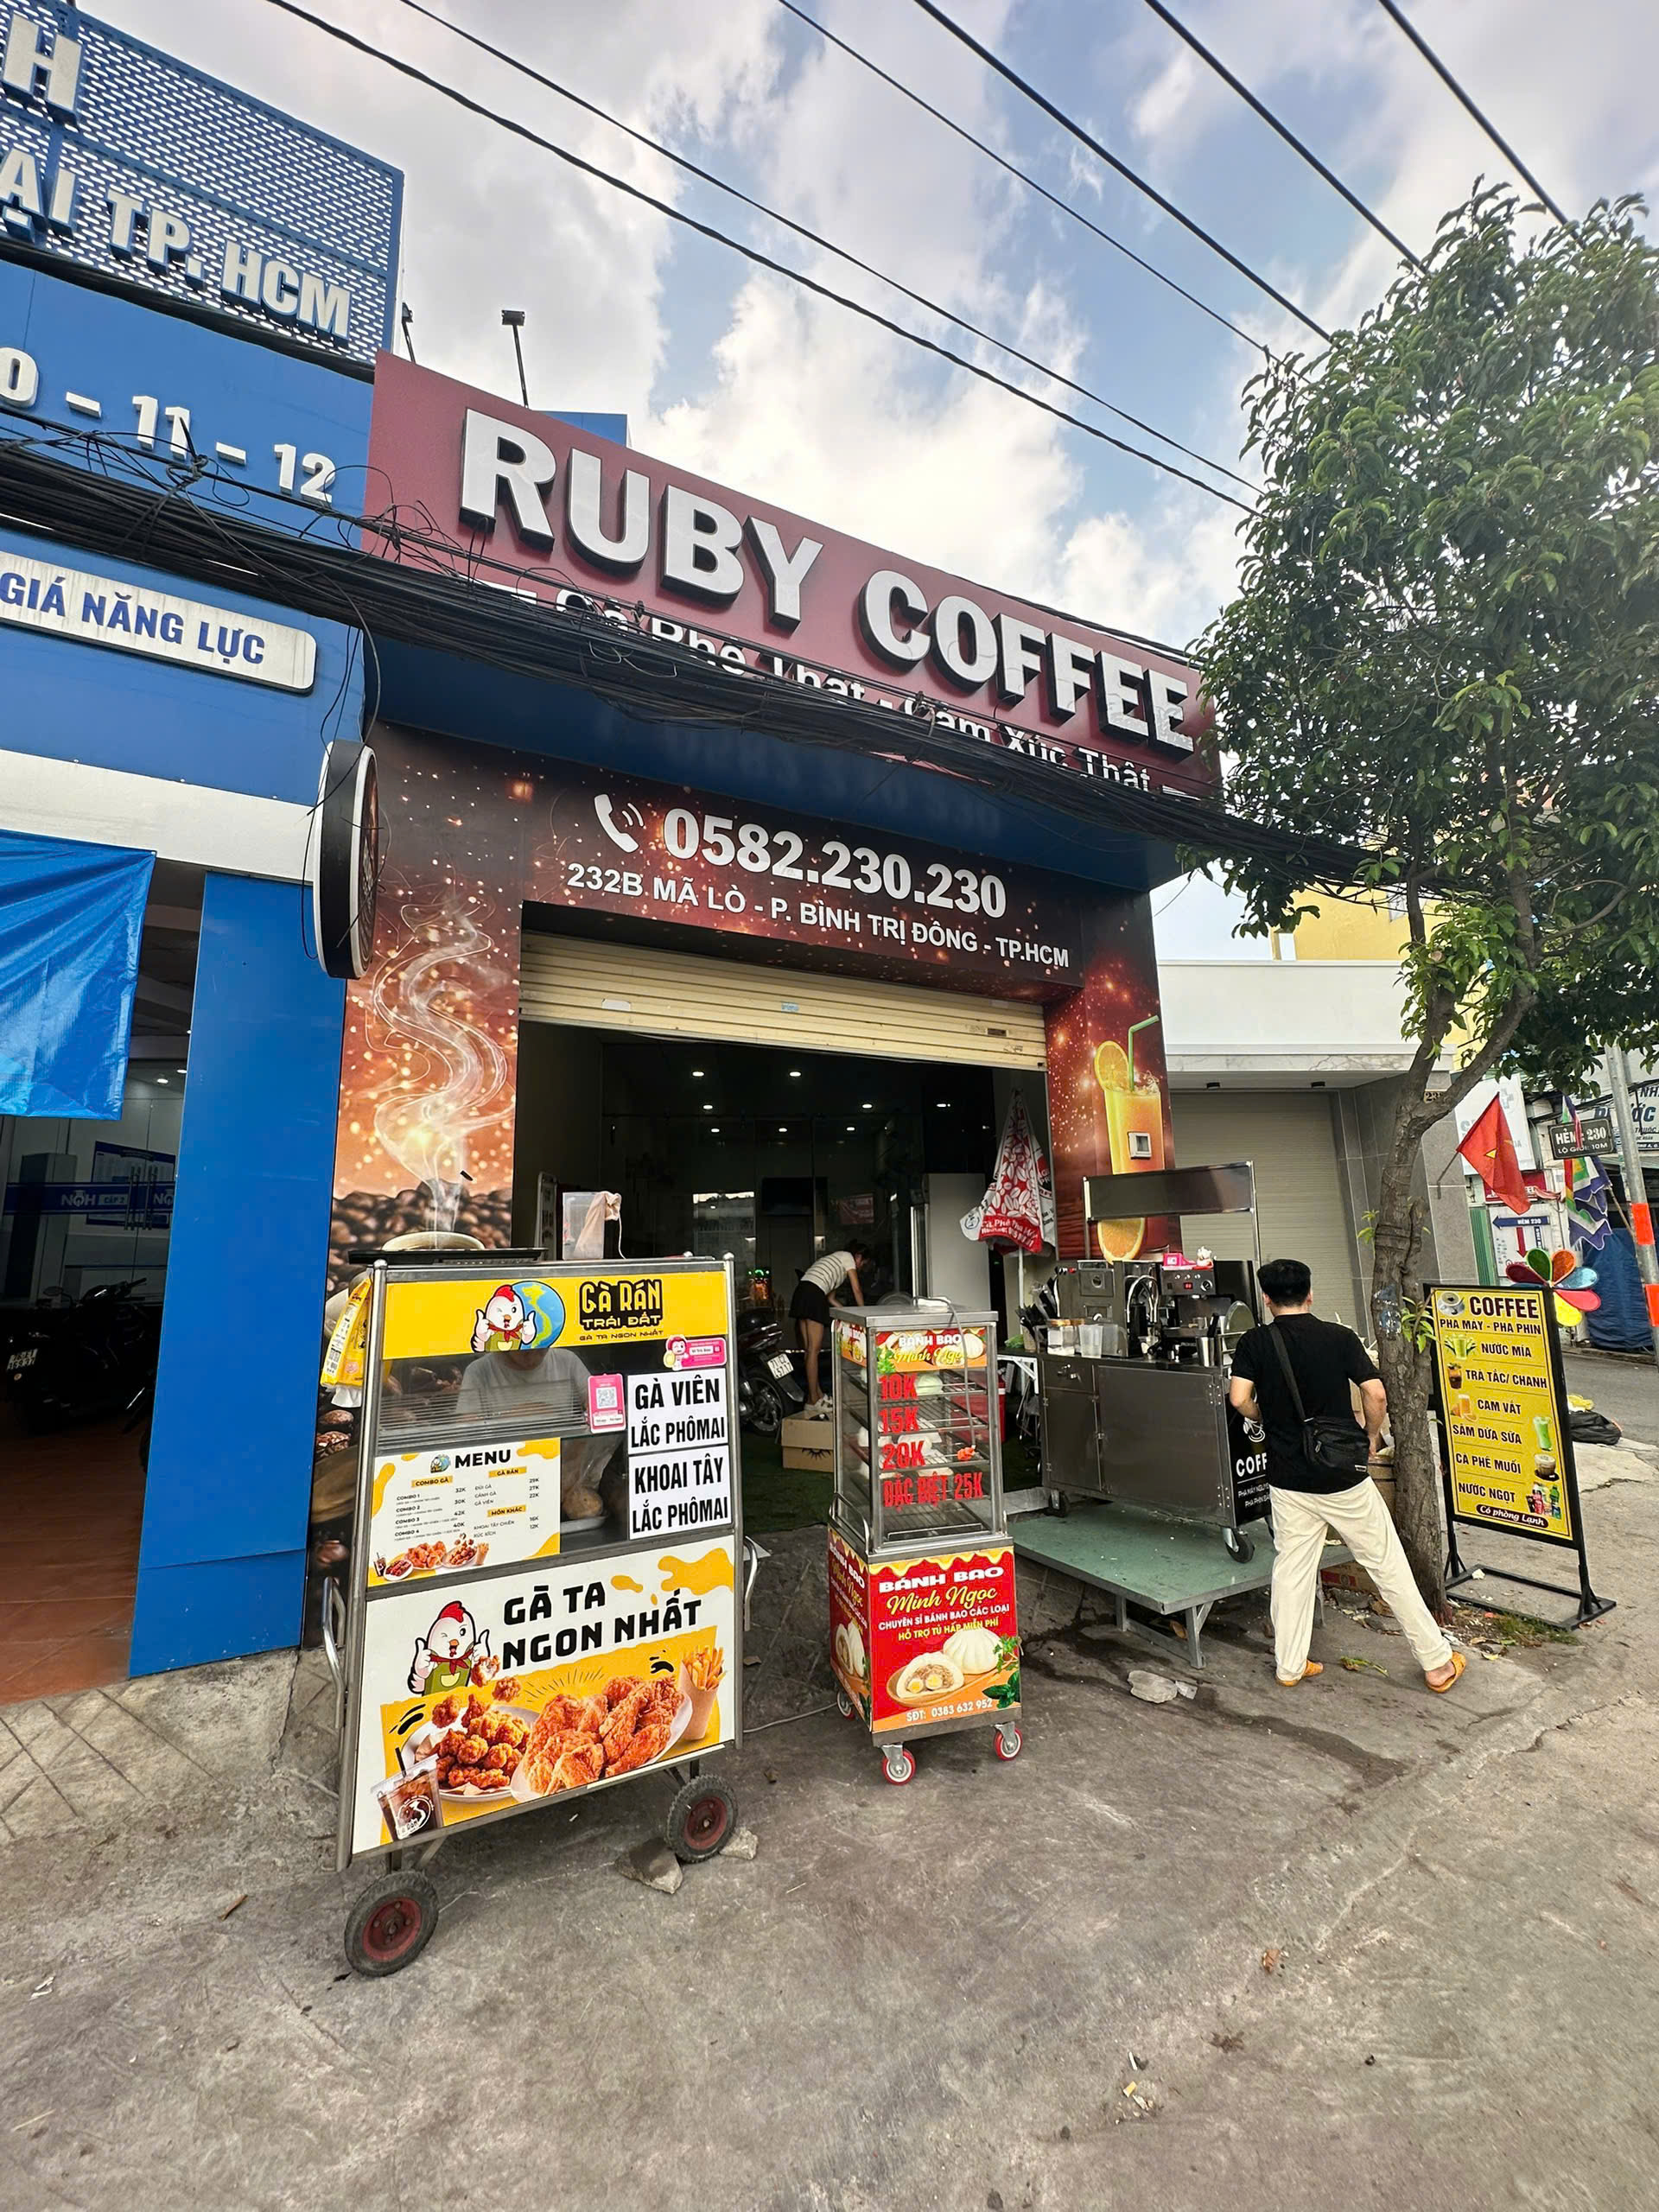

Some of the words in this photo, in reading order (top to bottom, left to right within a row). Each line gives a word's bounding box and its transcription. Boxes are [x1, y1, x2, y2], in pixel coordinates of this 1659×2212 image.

[220, 239, 351, 339] HCM
[132, 394, 190, 460] 11
[274, 442, 337, 505] 12
[460, 408, 824, 631] RUBY
[860, 569, 1195, 760] COFFEE
[0, 571, 67, 617] GIÁ
[81, 591, 185, 645] NĂNG
[197, 620, 265, 664] LỰC
[663, 807, 1007, 919] 0582.230.230
[566, 862, 644, 898] 232B
[652, 875, 699, 907] MÃ
[707, 884, 747, 914] LÒ
[771, 897, 791, 922] P.
[799, 899, 861, 934] BÌNH
[867, 914, 906, 946] TRỊ
[911, 920, 979, 953] ĐÔNG
[995, 937, 1070, 969] TP.HCM
[1586, 1126, 1607, 1141] 230
[1591, 1141, 1608, 1150] 10M
[582, 1282, 612, 1314] GÀ
[619, 1281, 661, 1312] RÁN
[1469, 1296, 1539, 1319] COFFEE
[582, 1315, 621, 1329] TRÁI
[627, 1311, 662, 1326] ĐẤT
[1440, 1319, 1459, 1329] PHA
[1462, 1318, 1484, 1331] MÁY
[1493, 1321, 1514, 1333] PHA
[1516, 1323, 1541, 1335] PHIN
[1481, 1342, 1510, 1356] NƯỚC
[1511, 1344, 1532, 1357] MÍA
[634, 1377, 664, 1410] GÀ
[671, 1374, 720, 1407] VIÊN
[879, 1373, 919, 1402] 10K
[1465, 1368, 1485, 1382] TRÀ
[1512, 1374, 1548, 1389] CHANH
[1477, 1399, 1501, 1412] CAM
[631, 1415, 660, 1448] LẮC
[665, 1414, 725, 1445] PHÔMAI
[879, 1406, 920, 1436] 15K
[454, 1449, 512, 1469] MENU
[881, 1440, 926, 1471] 20K
[1236, 1452, 1268, 1478] COFF
[1455, 1452, 1470, 1465] CÀ
[1471, 1455, 1492, 1469] PHÊ
[1494, 1459, 1522, 1474] MUỐI
[415, 1478, 439, 1487] COMBO
[634, 1460, 688, 1495] KHOAI
[692, 1452, 724, 1486] TÂY
[953, 1471, 983, 1501] 25K
[1458, 1481, 1486, 1497] NƯỚC
[1489, 1487, 1516, 1504] NGỌT
[632, 1499, 663, 1534] LẮC
[667, 1496, 728, 1528] PHÔMAI
[1479, 1505, 1491, 1515] Có
[1492, 1508, 1520, 1522] phòng
[1522, 1514, 1545, 1527] Lạnh
[878, 1573, 947, 1594] BÁNH
[953, 1566, 1005, 1583] BAO
[563, 1581, 606, 1614] TA
[886, 1588, 943, 1616] Minh
[944, 1585, 998, 1610] Ngọc
[502, 1621, 603, 1671] NGON
[613, 1587, 702, 1644] NHẤT
[877, 1616, 913, 1631] CHUYÊN
[924, 1610, 949, 1624] BÁNH
[950, 1609, 969, 1620] BAO
[969, 1604, 989, 1617] CÁC
[990, 1603, 1011, 1616] LOẠI
[956, 1700, 975, 1713] 632
[975, 1697, 994, 1710] 952
